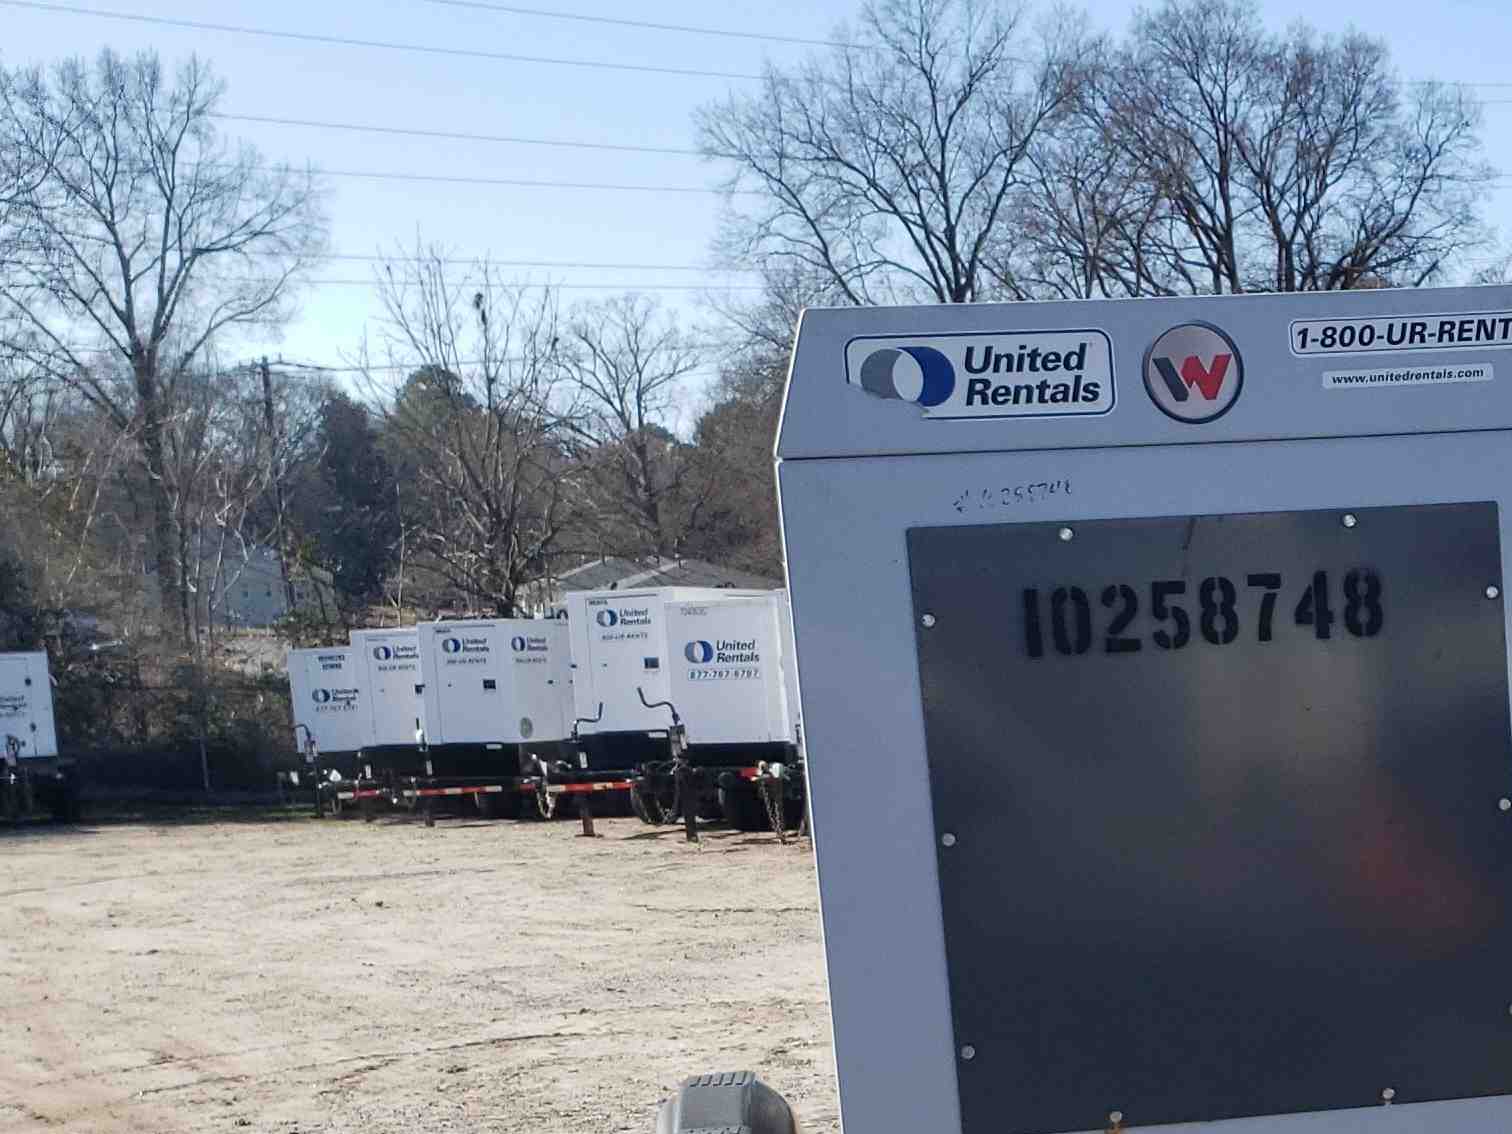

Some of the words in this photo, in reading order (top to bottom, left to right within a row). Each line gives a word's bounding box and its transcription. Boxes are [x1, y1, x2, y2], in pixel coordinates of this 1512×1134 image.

[963, 342, 1088, 374] United
[1331, 366, 1485, 385] www.unitedrentals.com
[965, 374, 1102, 407] Rentals
[1021, 566, 1384, 662] 10258748
[716, 639, 756, 651] United
[716, 651, 760, 663] Rentals
